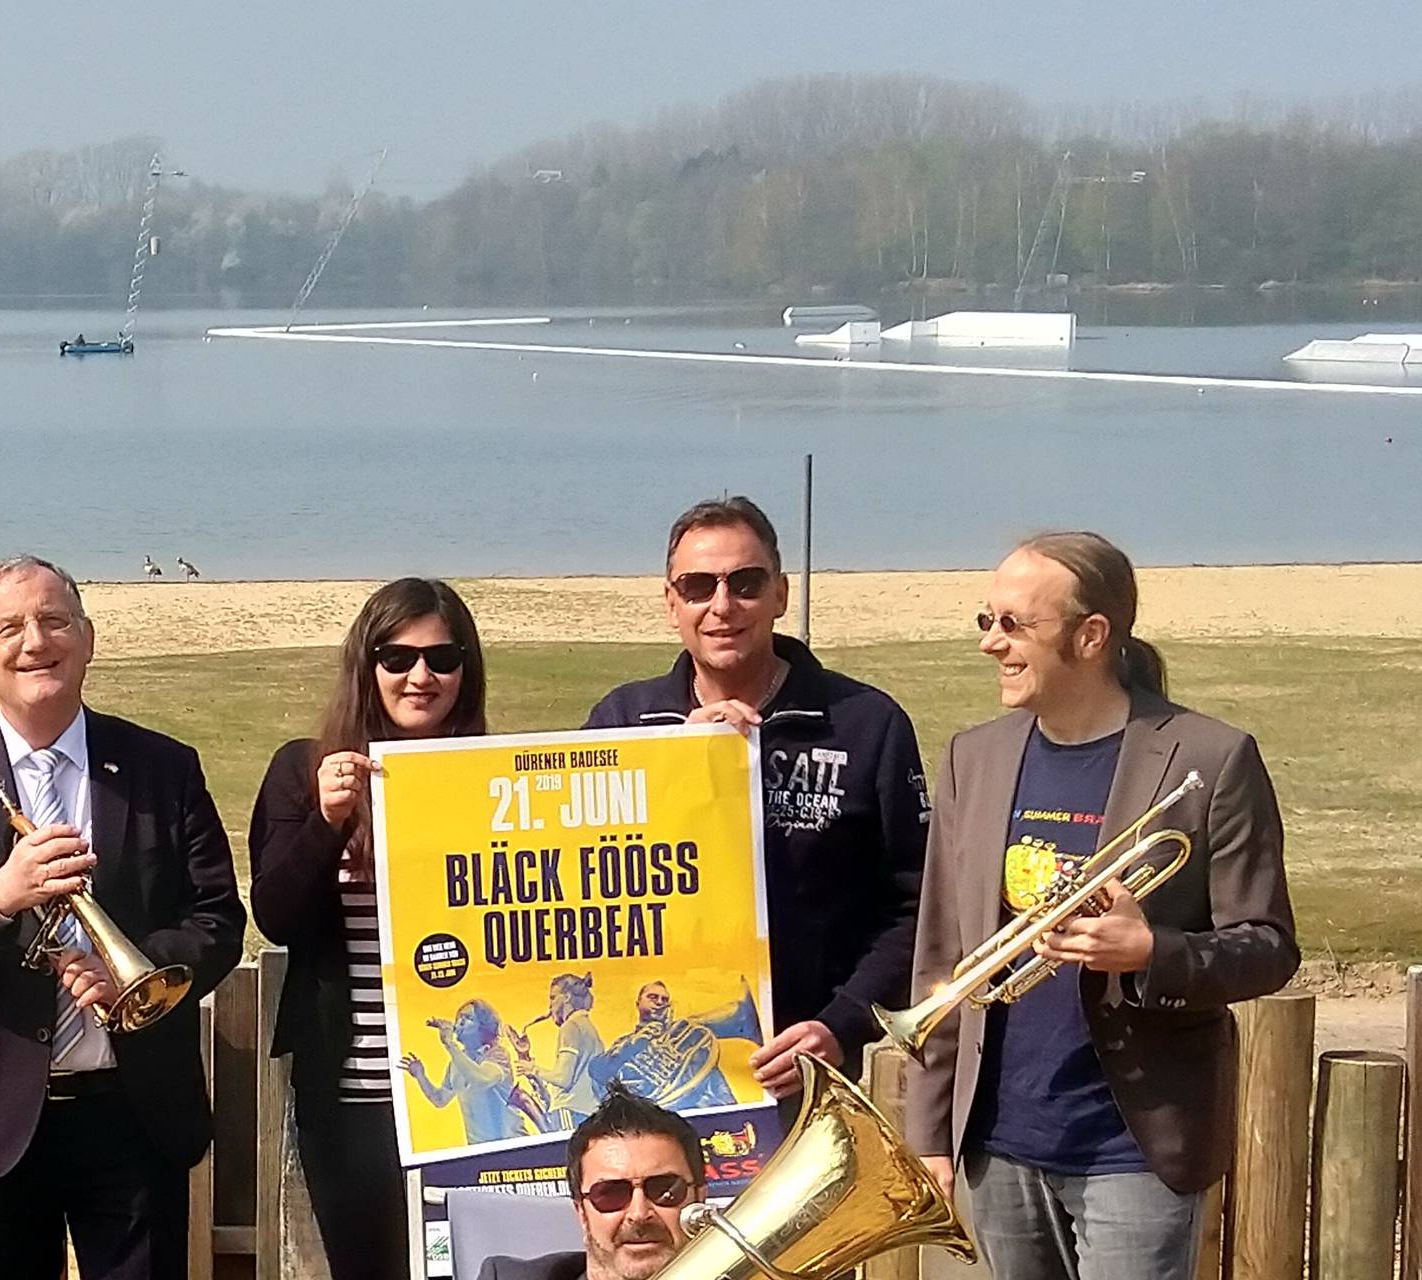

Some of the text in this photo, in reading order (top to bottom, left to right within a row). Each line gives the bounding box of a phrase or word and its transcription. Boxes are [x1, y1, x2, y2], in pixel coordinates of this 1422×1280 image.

[515, 749, 619, 772] DÜRENER BADESEE
[489, 768, 649, 832] 21. 2019 JUNI
[768, 790, 839, 811] THE OCEAN
[1073, 813, 1105, 826] BRA
[445, 833, 700, 908] BLÄCK FÖÖSS
[483, 903, 667, 969] QUERBEAT
